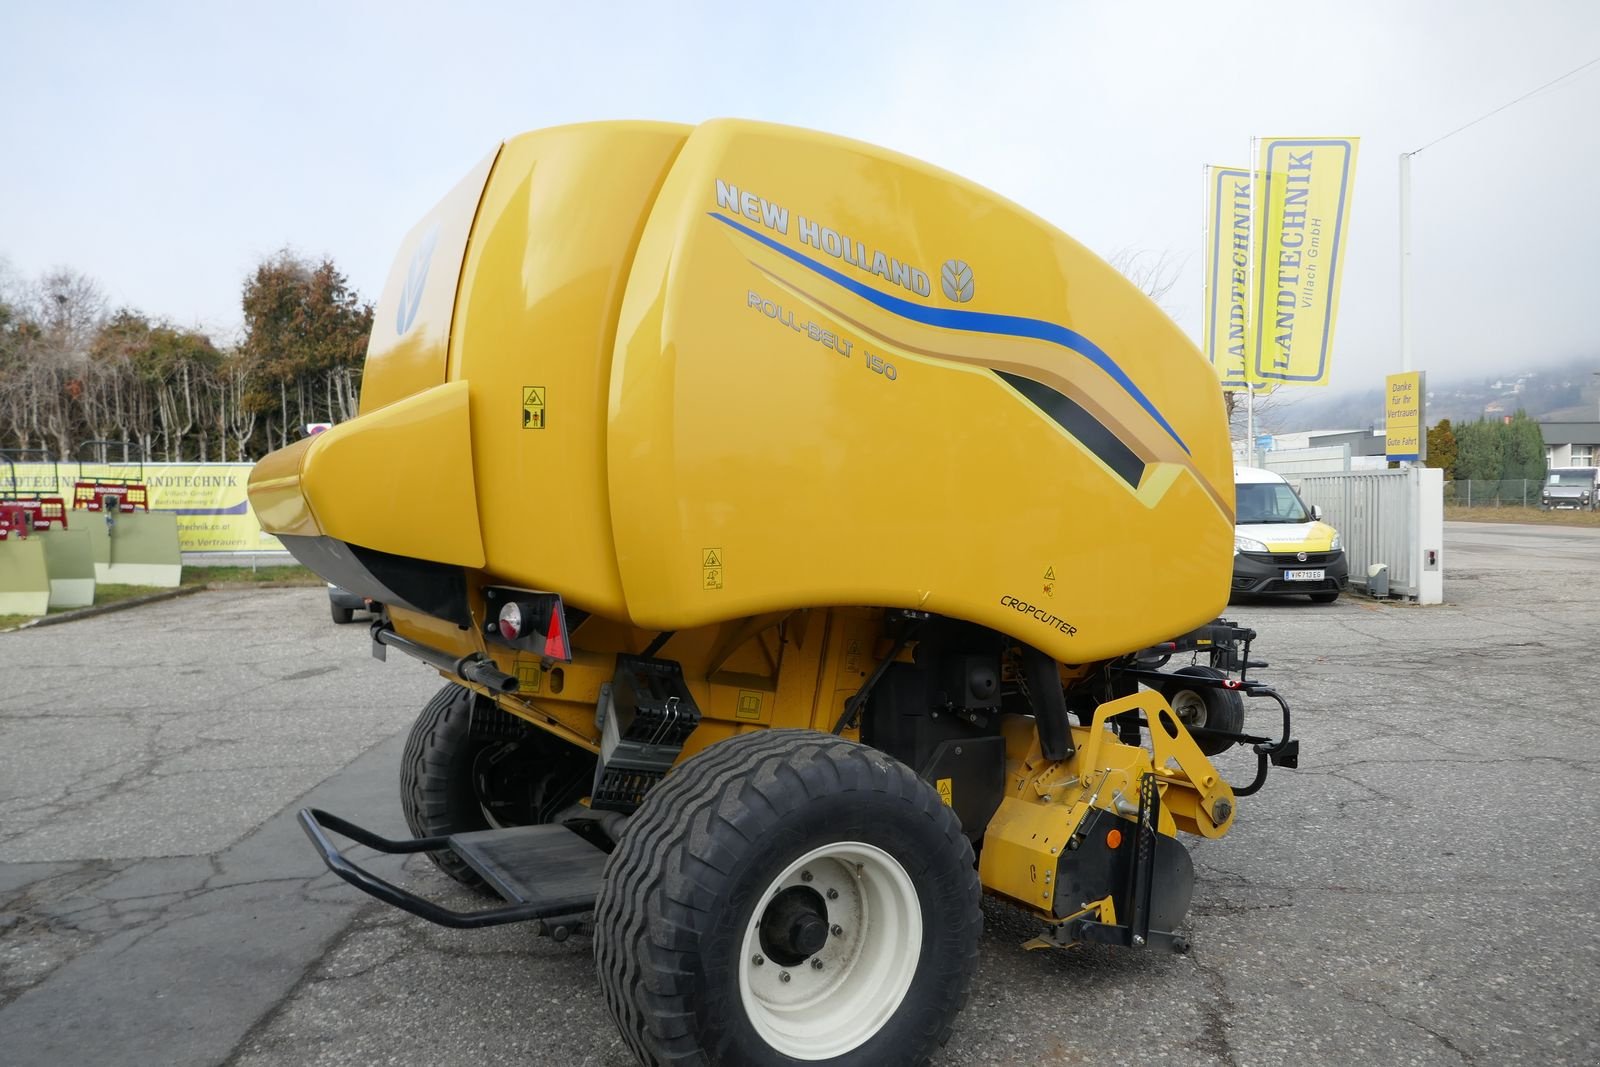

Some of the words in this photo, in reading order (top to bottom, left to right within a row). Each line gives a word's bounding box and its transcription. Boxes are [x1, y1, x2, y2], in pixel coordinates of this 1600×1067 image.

[715, 178, 790, 236] NEW
[798, 214, 931, 298] HOLLAND
[1308, 218, 1322, 258] GmbH
[1226, 181, 1250, 378] LANDTECHNIK
[1273, 150, 1314, 370] LANDTECHNIK
[1301, 263, 1317, 309] Villach
[747, 289, 854, 358] ROLL-BELT
[863, 350, 897, 381] 150
[1392, 381, 1412, 392] Danke
[1392, 395, 1401, 405] für
[1403, 394, 1412, 404] Ihr
[1387, 409, 1417, 418] Vertrauen
[1387, 438, 1401, 446] Gute
[1402, 437, 1417, 446] Fahrt
[1000, 595, 1077, 637] CROPCUTTER
